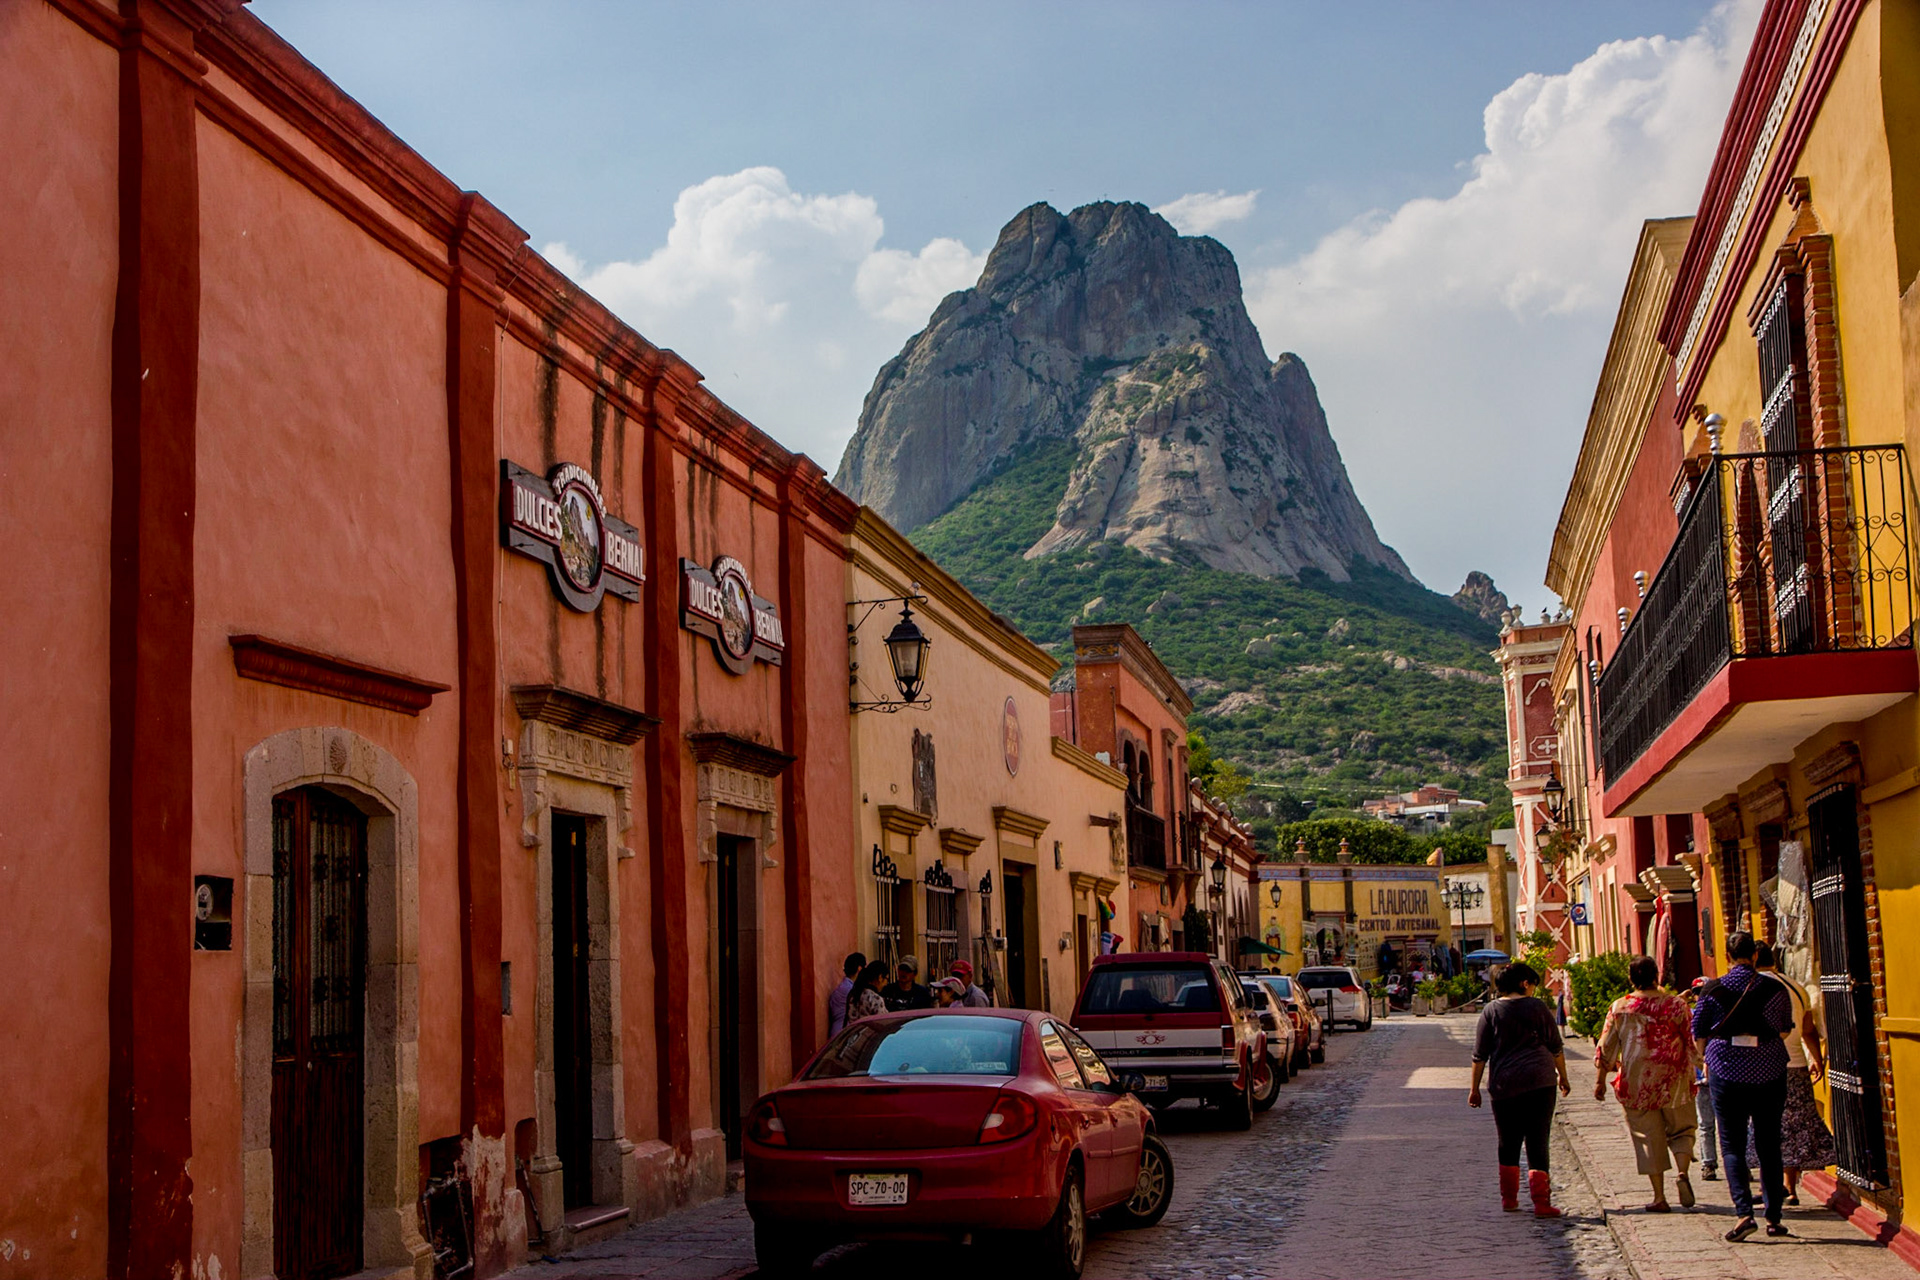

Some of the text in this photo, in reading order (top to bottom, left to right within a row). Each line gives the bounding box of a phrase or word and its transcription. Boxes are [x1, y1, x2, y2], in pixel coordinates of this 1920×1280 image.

[553, 464, 607, 518] TRADICIONALES
[516, 485, 646, 581] DULCES BERNAL
[691, 578, 785, 648] DULCES BERNAL
[1359, 918, 1441, 931] CENTRO ARTESANAL
[851, 1181, 905, 1195] SPC-70-00
